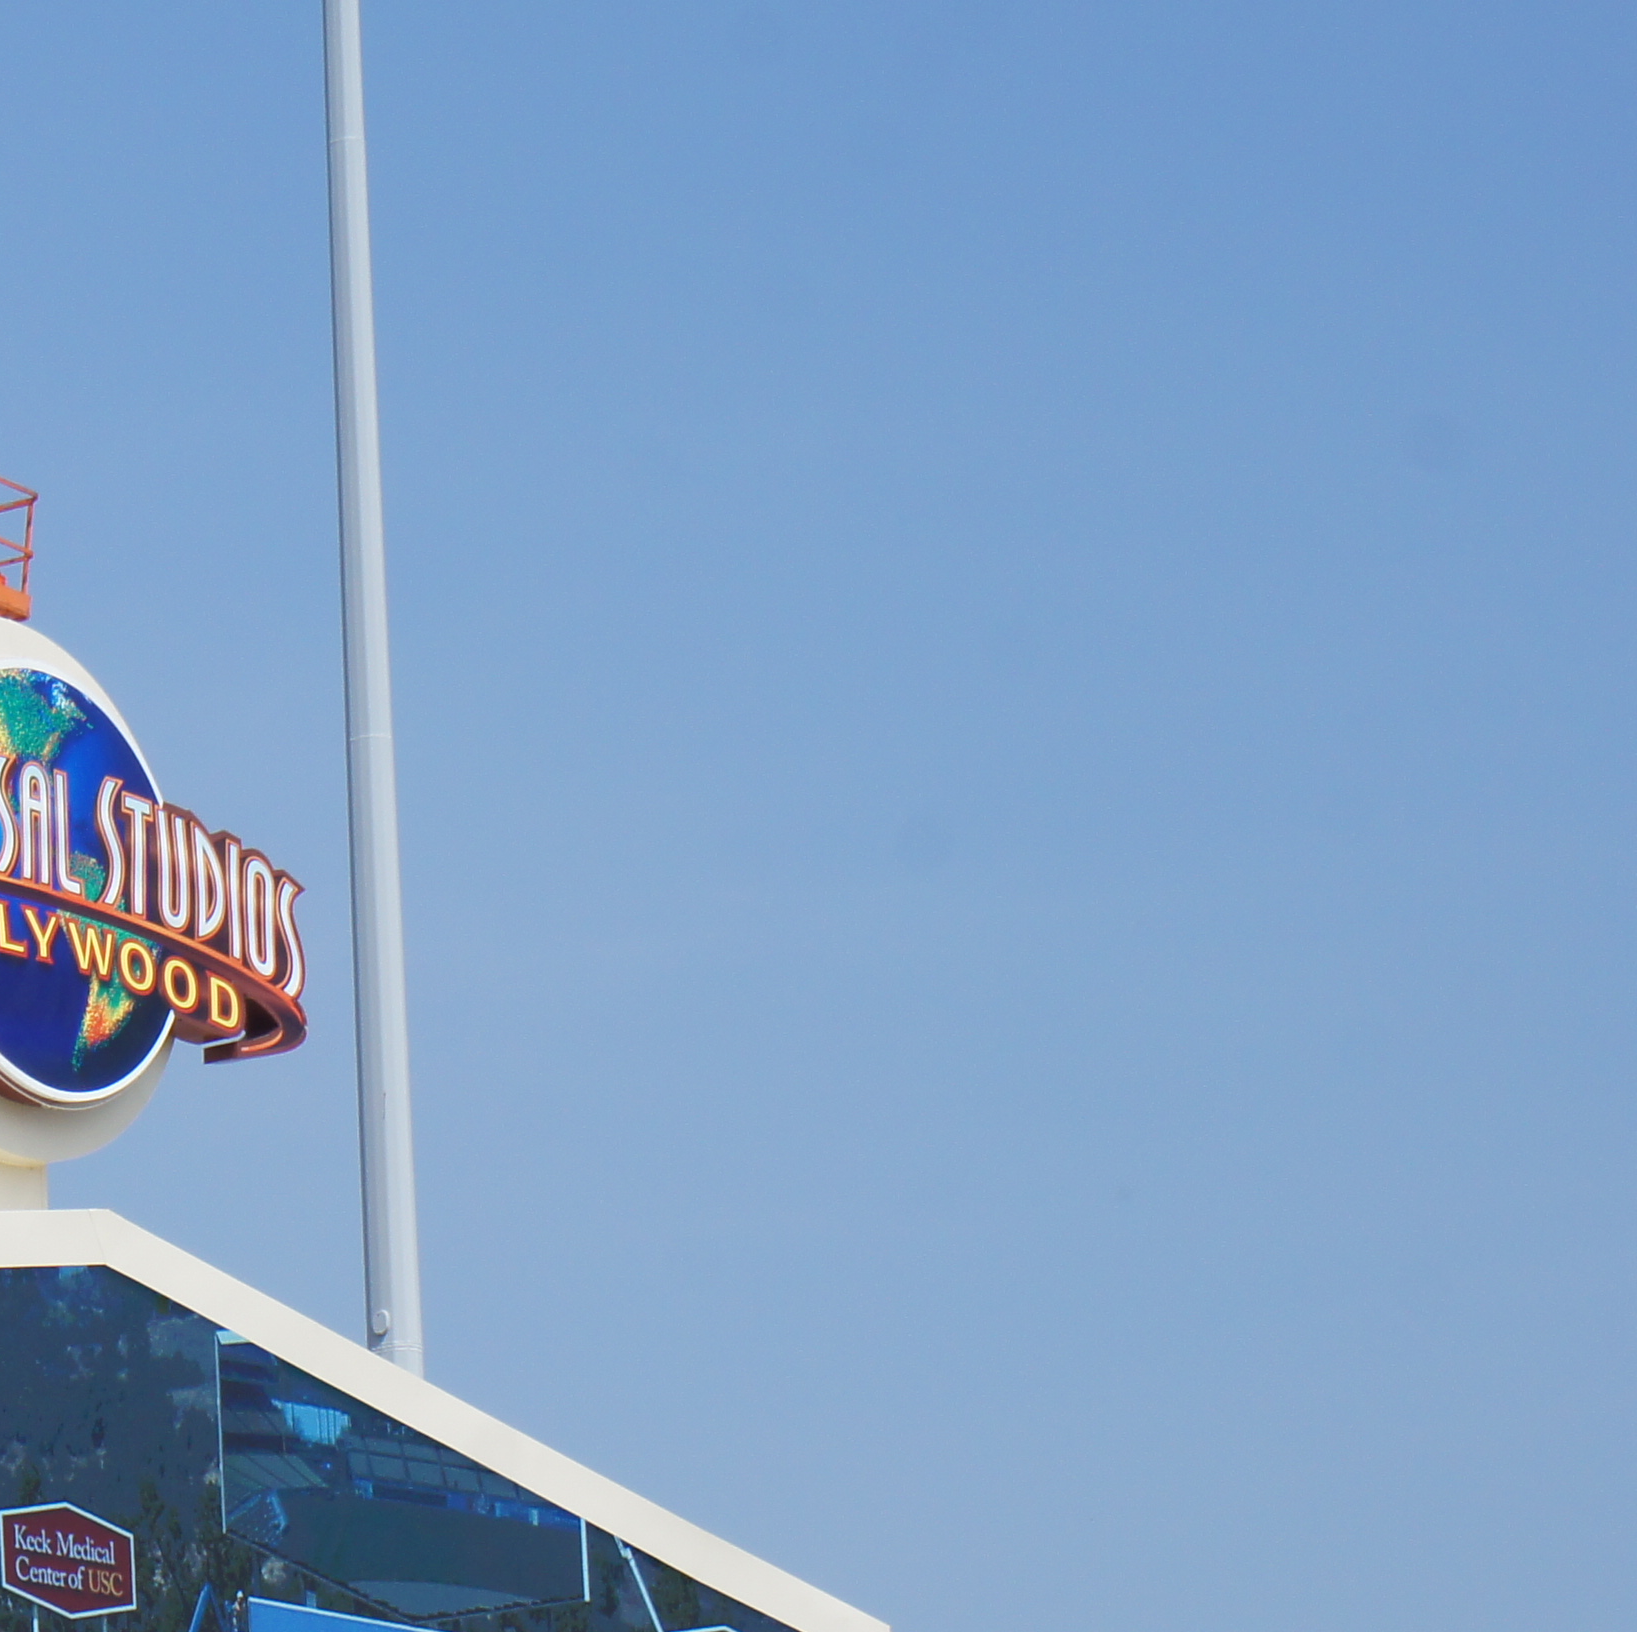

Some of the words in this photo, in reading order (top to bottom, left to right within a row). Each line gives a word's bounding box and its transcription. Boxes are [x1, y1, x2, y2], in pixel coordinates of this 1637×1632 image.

[96, 775, 305, 1001] STUDIOS
[13, 1523, 52, 1555] Keck
[55, 1531, 116, 1565] Medical
[15, 1556, 66, 1588] Center
[67, 1566, 87, 1590] of
[88, 1569, 123, 1597] USC
